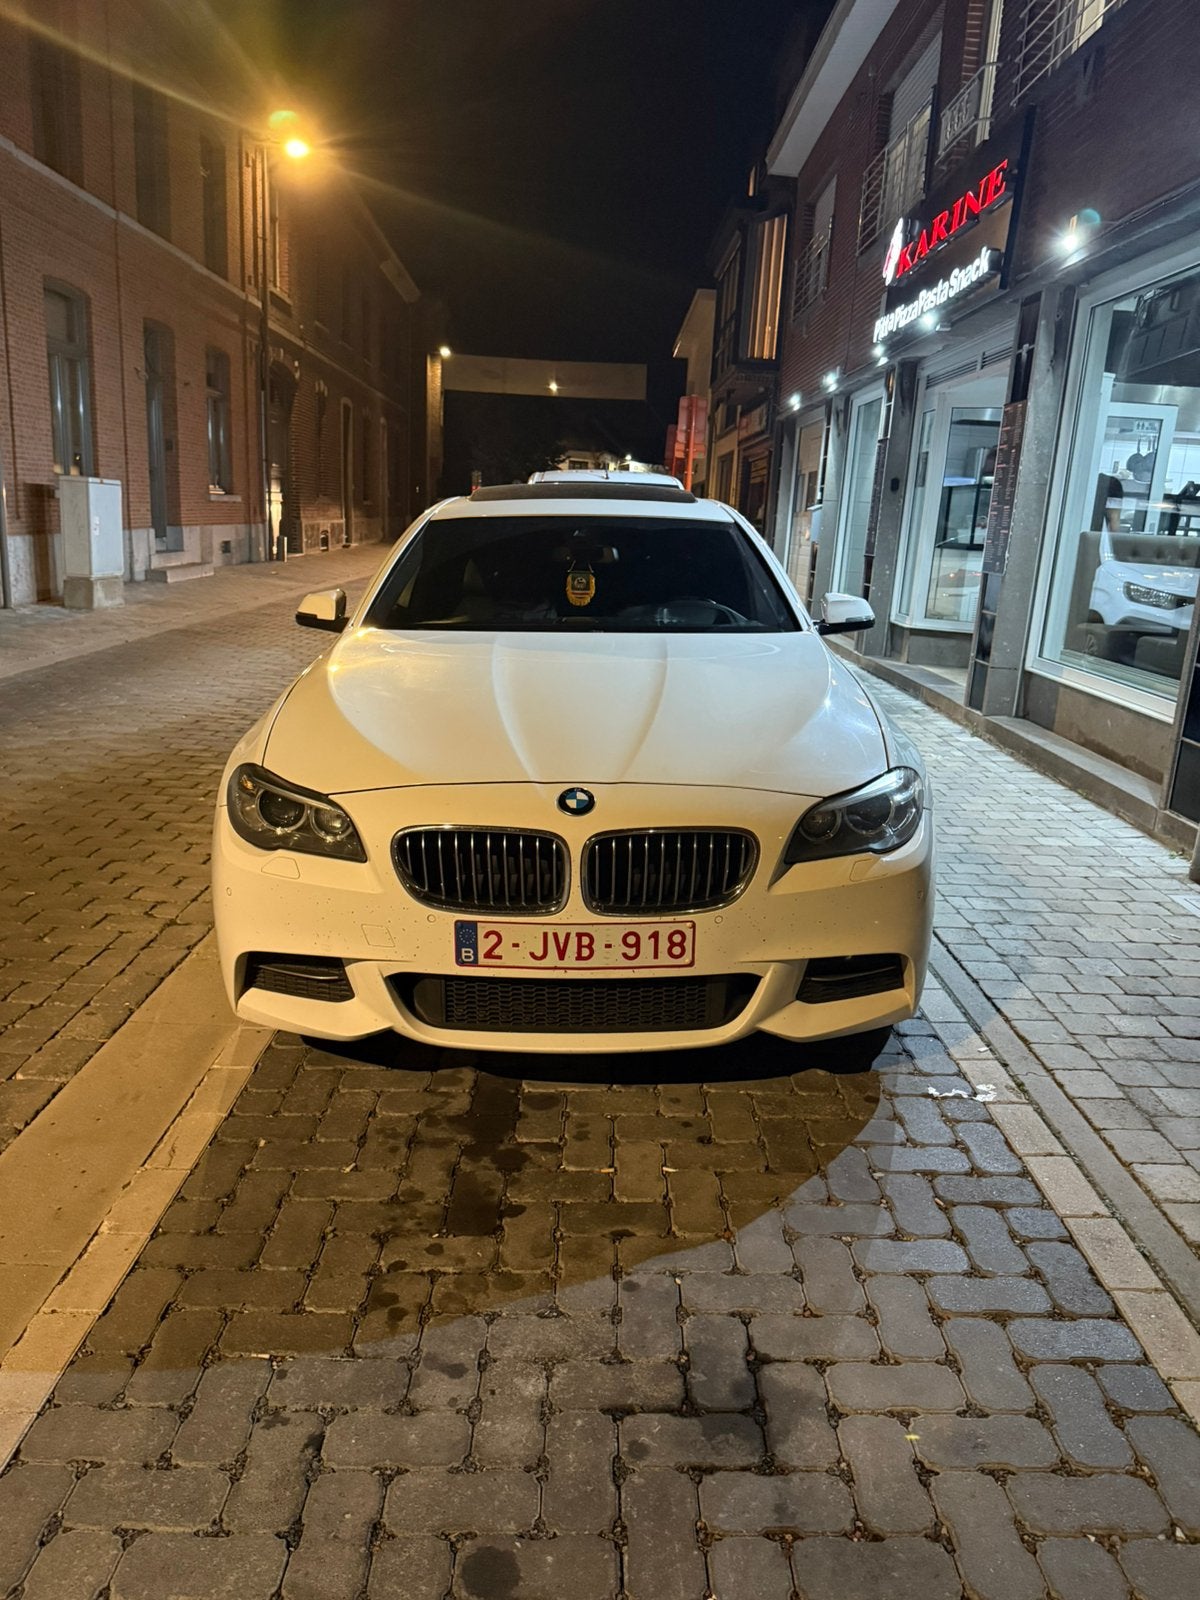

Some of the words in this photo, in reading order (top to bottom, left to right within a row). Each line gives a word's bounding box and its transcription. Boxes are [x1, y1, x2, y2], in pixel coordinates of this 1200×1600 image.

[896, 158, 1008, 278] KARINE
[893, 300, 920, 332] Pizza
[918, 279, 949, 316] Pasta
[949, 246, 991, 297] Snack
[461, 948, 474, 962] B
